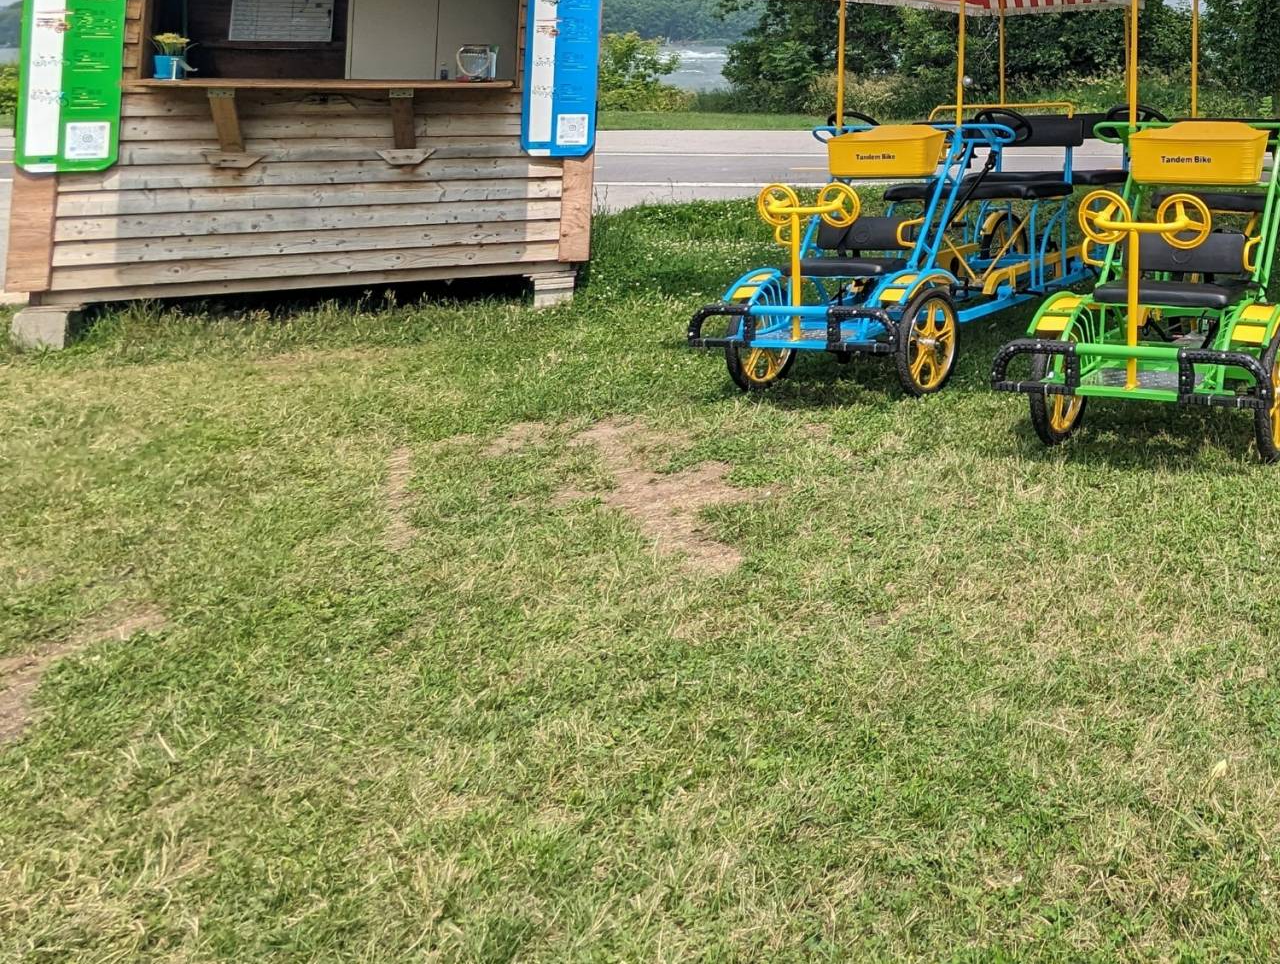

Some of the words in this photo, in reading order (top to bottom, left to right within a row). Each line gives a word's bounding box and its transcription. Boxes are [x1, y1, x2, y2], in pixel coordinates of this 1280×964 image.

[855, 153, 881, 161] Tandem
[1160, 155, 1193, 164] Tandem
[1194, 155, 1212, 164] Bike
